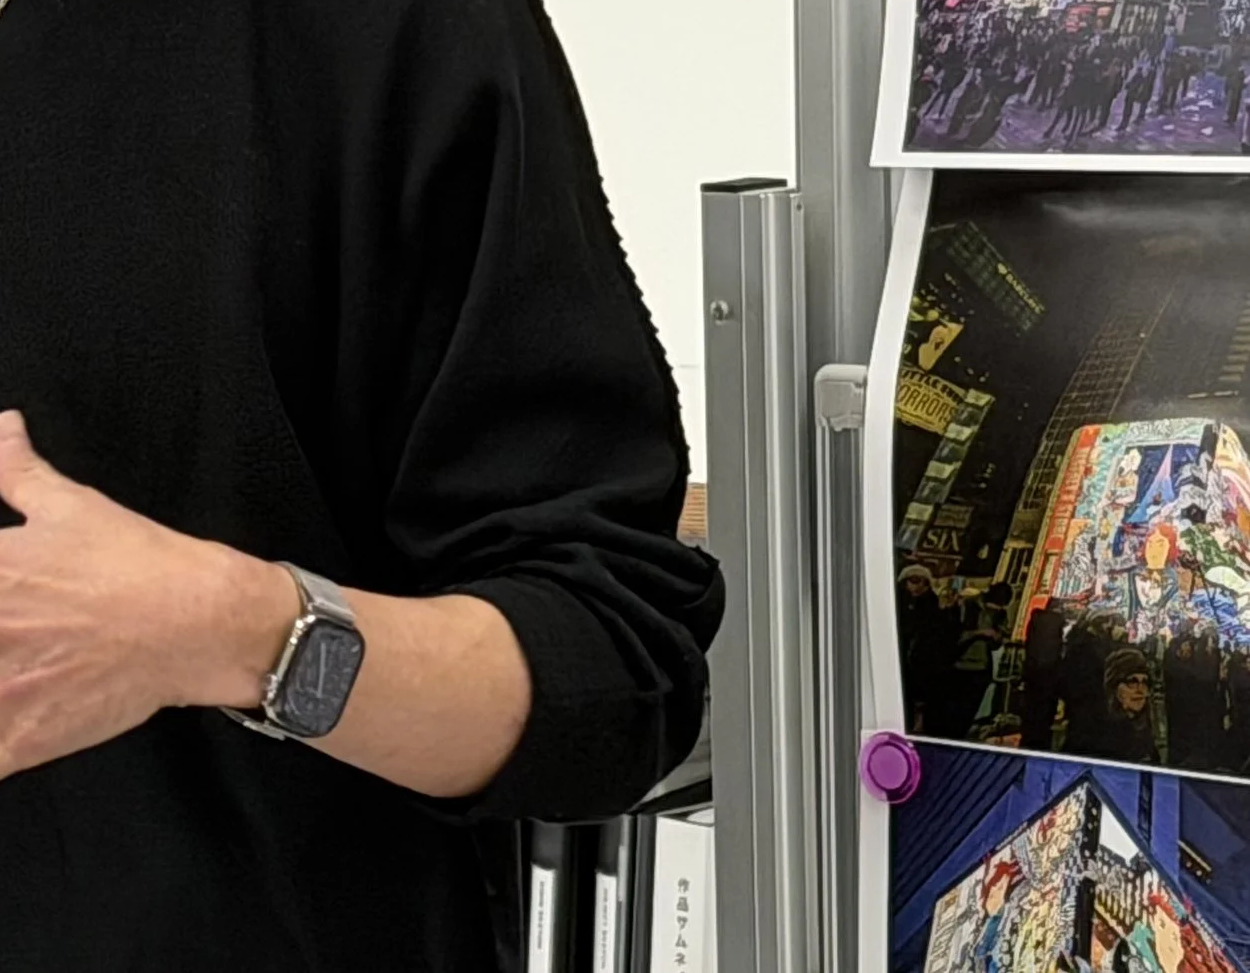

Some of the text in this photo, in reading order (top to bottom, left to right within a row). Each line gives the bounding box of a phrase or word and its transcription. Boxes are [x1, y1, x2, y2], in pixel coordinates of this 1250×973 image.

[674, 877, 690, 973] 作品サムネ
